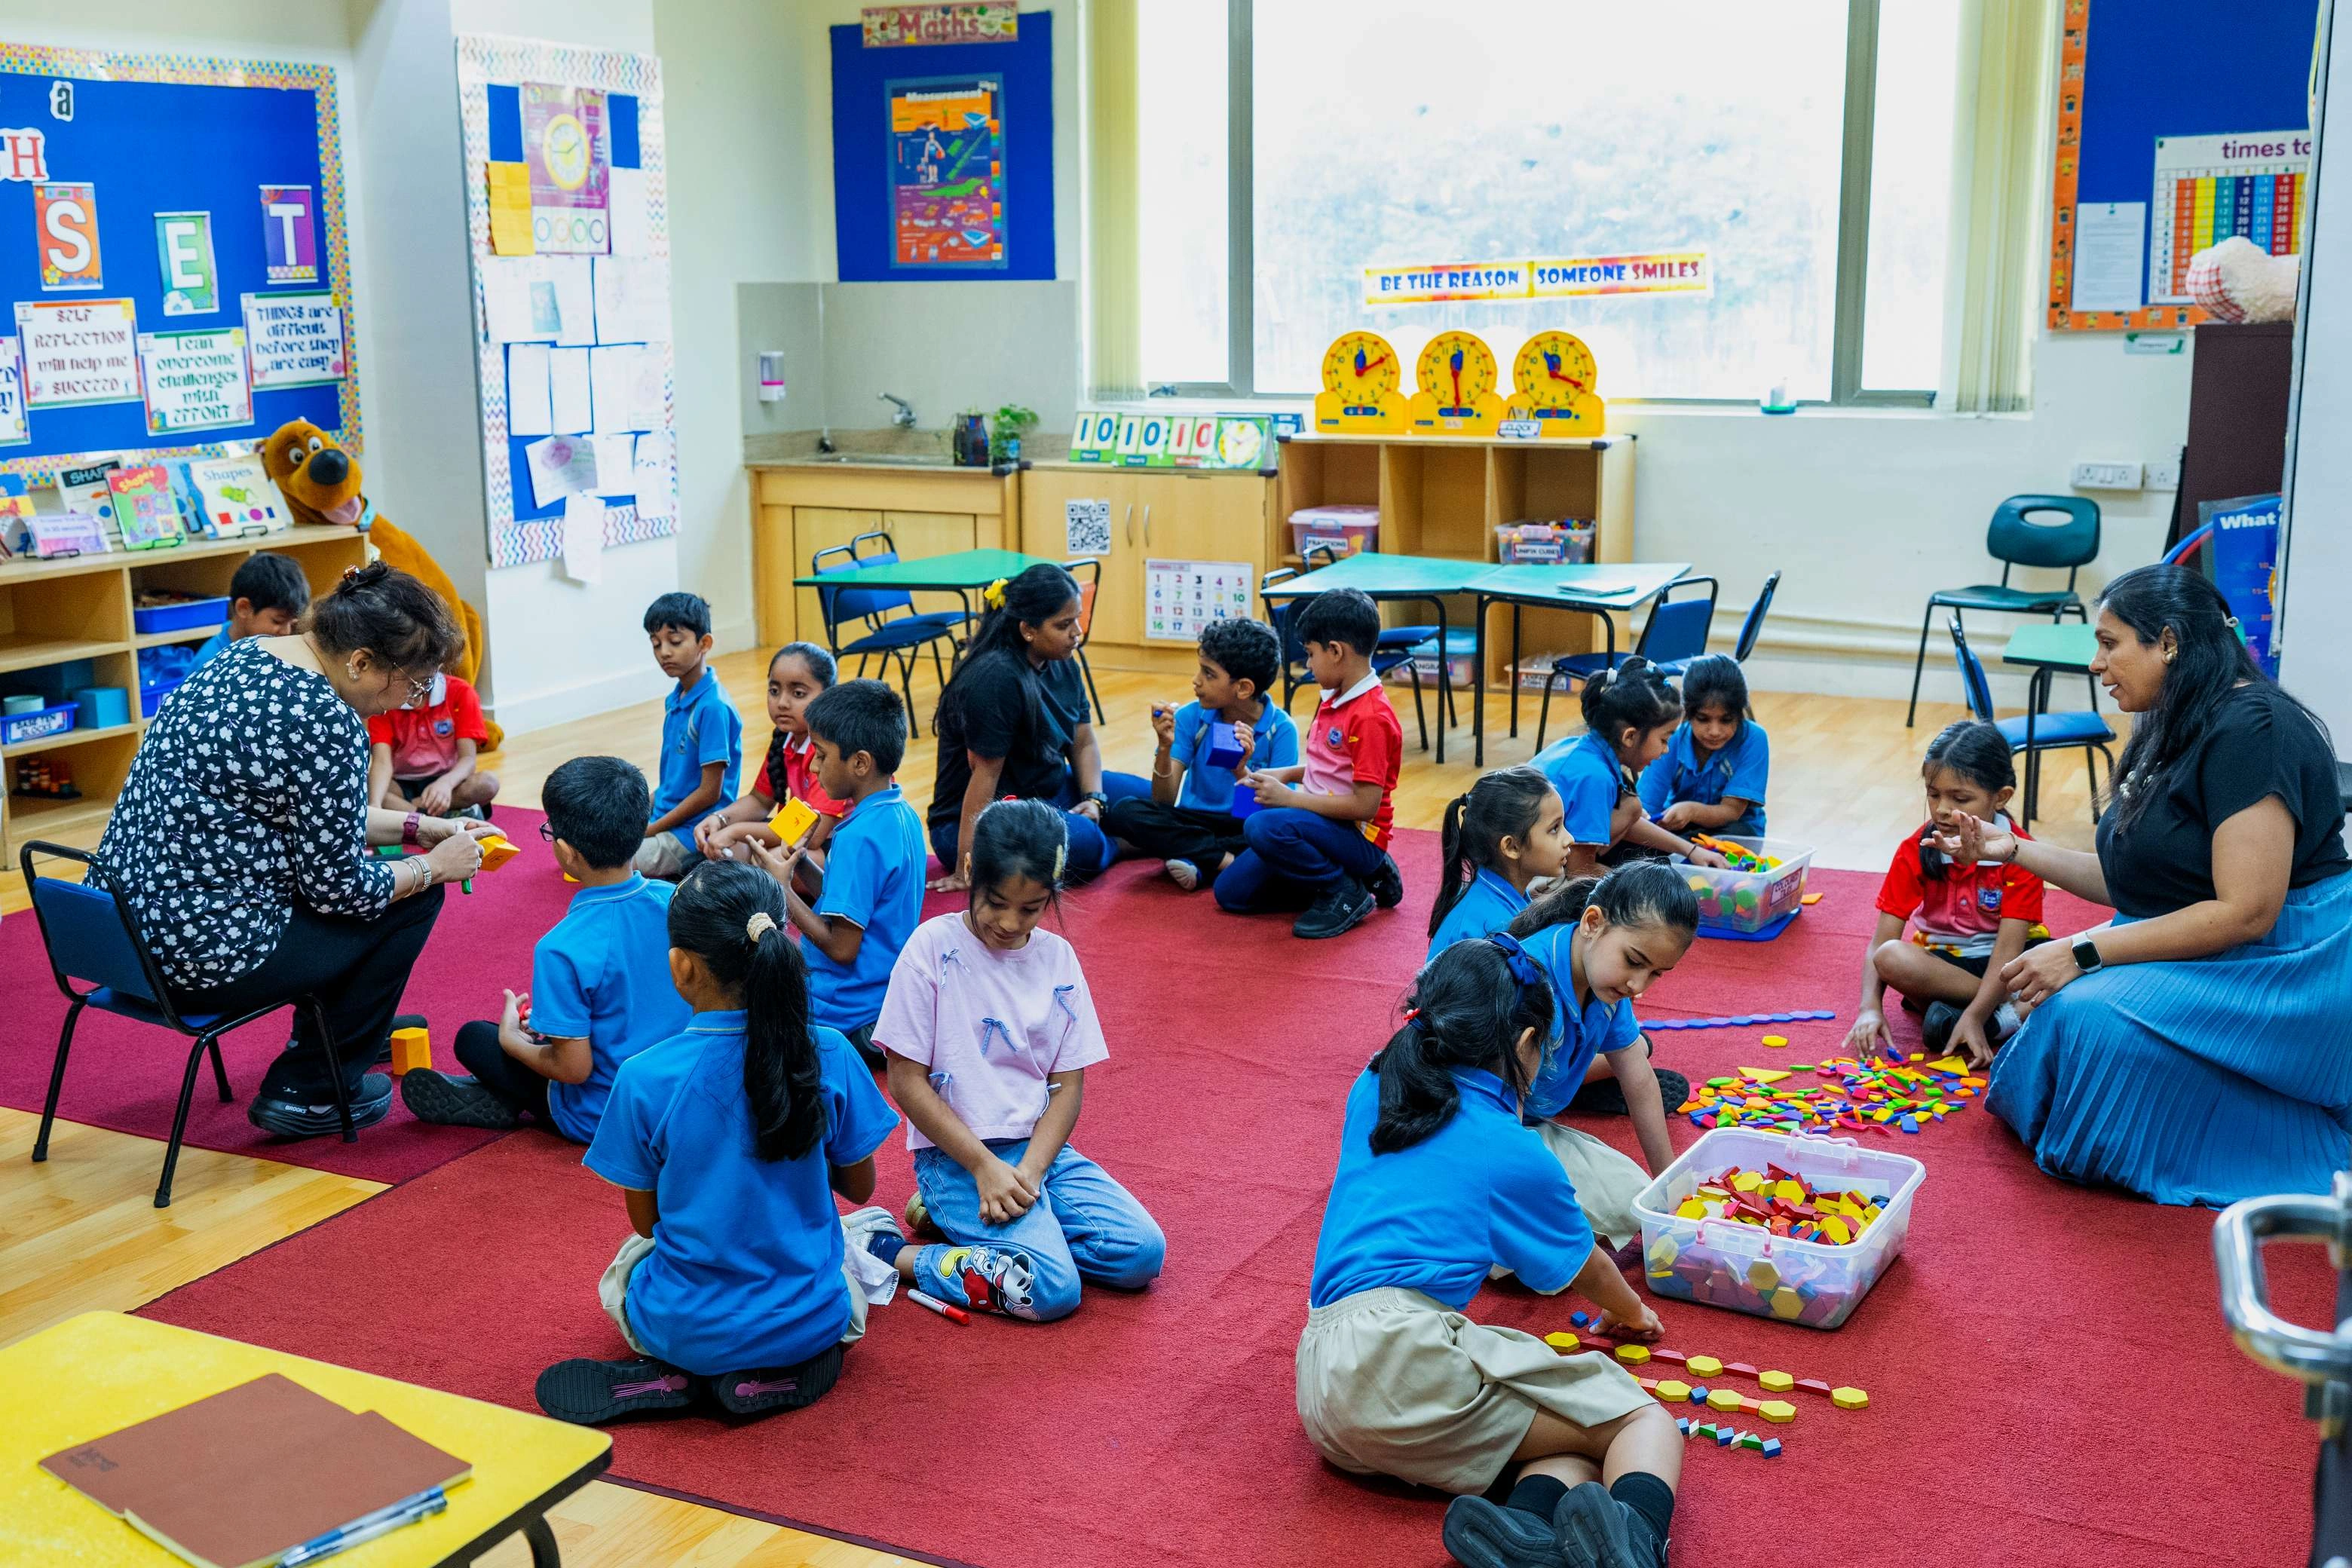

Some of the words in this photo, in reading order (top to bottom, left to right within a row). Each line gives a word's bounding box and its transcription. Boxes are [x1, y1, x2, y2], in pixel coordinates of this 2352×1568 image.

[899, 10, 978, 38] Maths
[2222, 141, 2285, 158] times
[1381, 276, 1401, 290] BE
[1408, 273, 1443, 289] THE
[1448, 271, 1518, 287] REASON
[1538, 265, 1626, 283] SOMEONE
[1632, 262, 1698, 279] SMILES
[257, 306, 303, 321] THINGS
[309, 307, 332, 317] are
[267, 323, 326, 336] difficult
[35, 331, 125, 348] REFLECTION
[185, 338, 213, 350] can
[256, 341, 304, 354] before
[310, 338, 339, 354] they
[38, 357, 65, 371] will
[71, 357, 102, 372] help
[106, 356, 127, 367] me
[157, 354, 234, 370] overcome
[271, 359, 294, 370] are
[299, 356, 329, 371] easy
[53, 378, 118, 394] SUCCEED
[158, 371, 237, 388] challenges
[182, 389, 219, 403] with
[174, 405, 229, 423] EFFORT
[204, 468, 253, 481] Shapes
[2220, 513, 2276, 530] What
[1176, 574, 1182, 583] 2
[1196, 575, 1202, 584] 3
[1216, 577, 1222, 585] 4
[1237, 577, 1243, 586] 5
[1155, 590, 1162, 598] 6
[1177, 591, 1182, 599] 7
[1196, 591, 1202, 600] 8
[1233, 593, 1245, 602] 10
[1155, 605, 1162, 614] 11
[1174, 607, 1183, 615] 12
[1193, 608, 1202, 617] 13
[1214, 608, 1226, 617] 14
[1153, 620, 1163, 630] 16
[1173, 622, 1183, 630] 17
[285, 1105, 307, 1113] BROOKS
